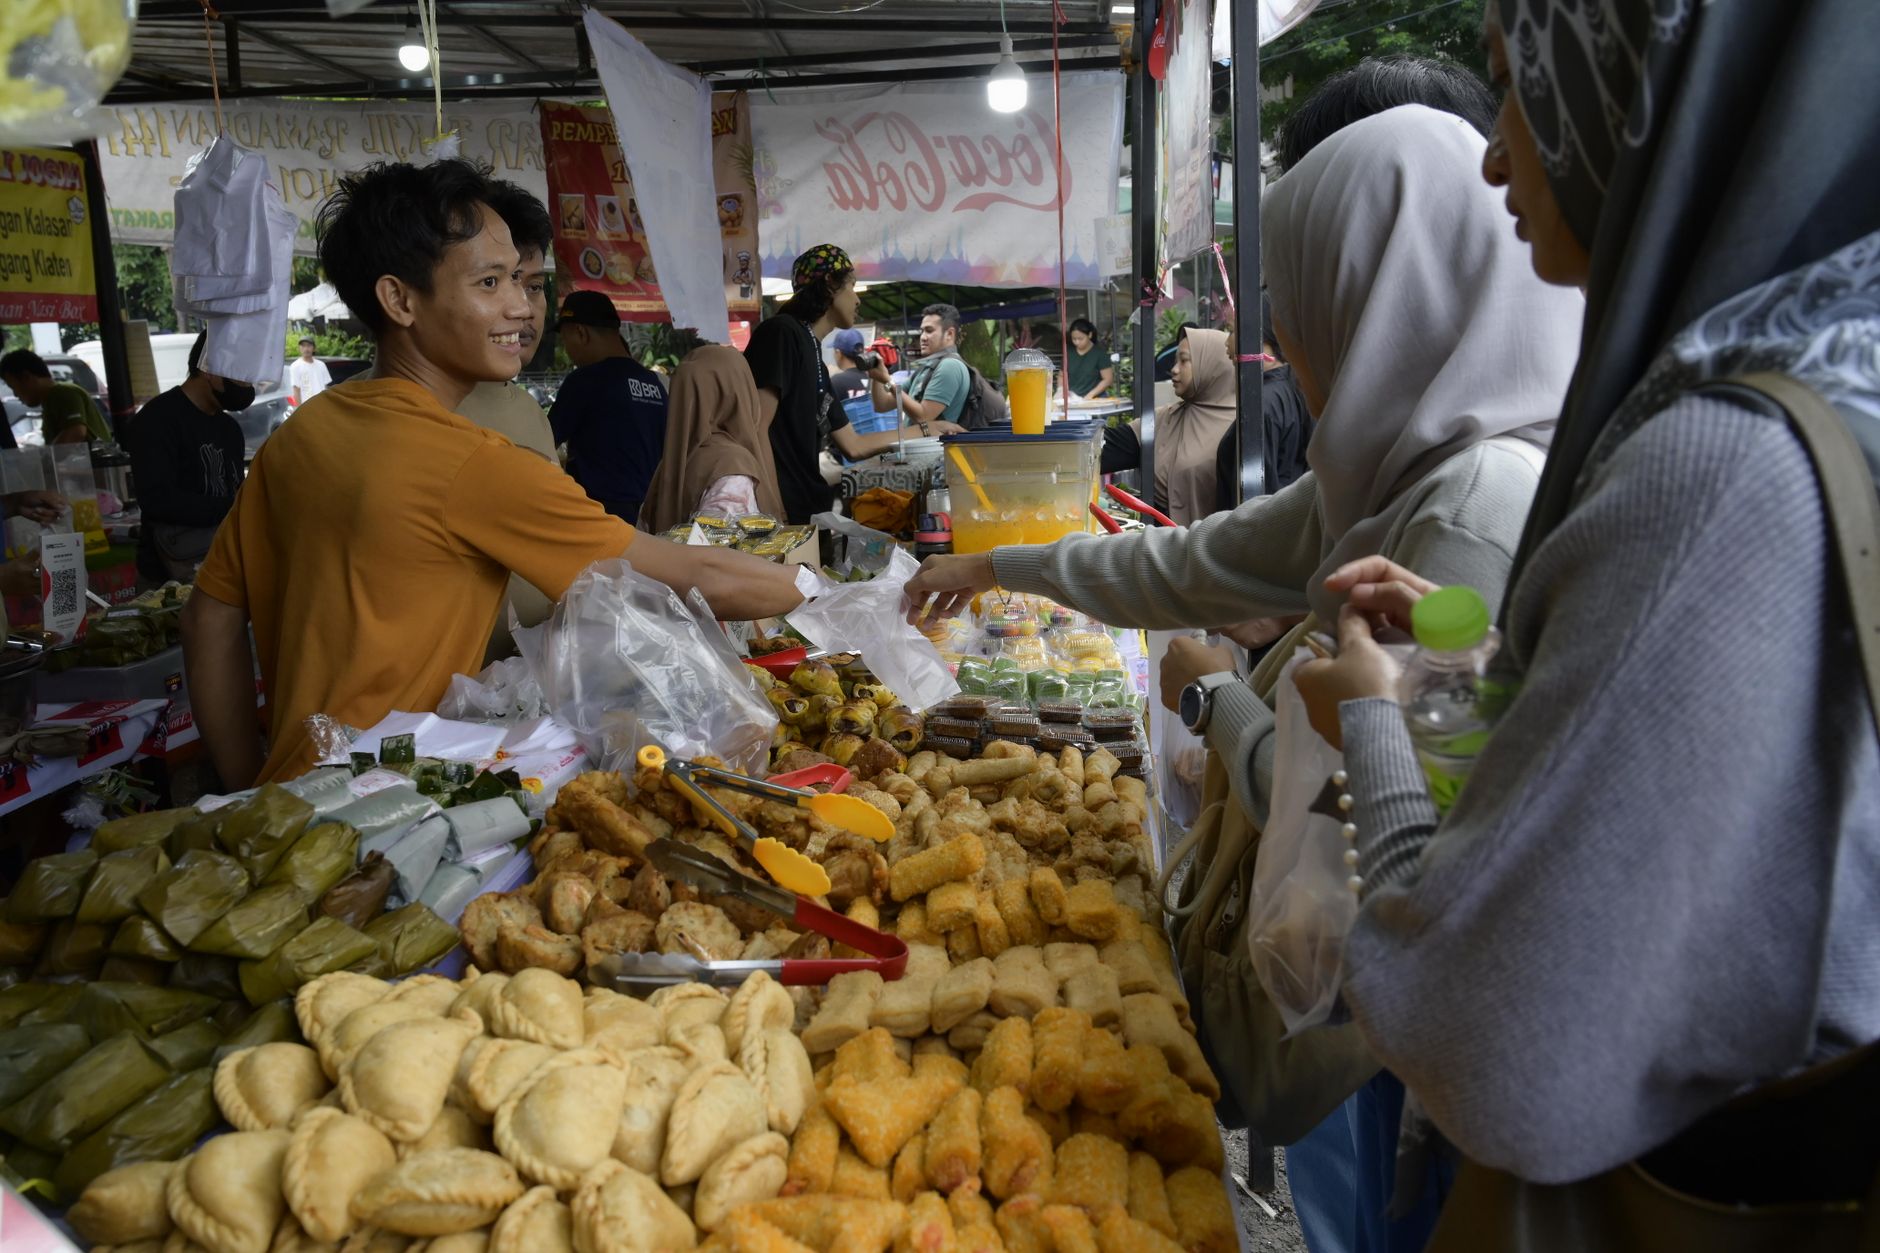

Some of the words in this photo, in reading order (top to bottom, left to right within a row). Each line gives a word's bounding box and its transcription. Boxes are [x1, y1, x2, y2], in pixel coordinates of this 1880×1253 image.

[16, 154, 83, 192] JOGJA
[24, 207, 73, 238] Kalasan
[32, 248, 73, 278] Klaten
[641, 382, 662, 400] BRI
